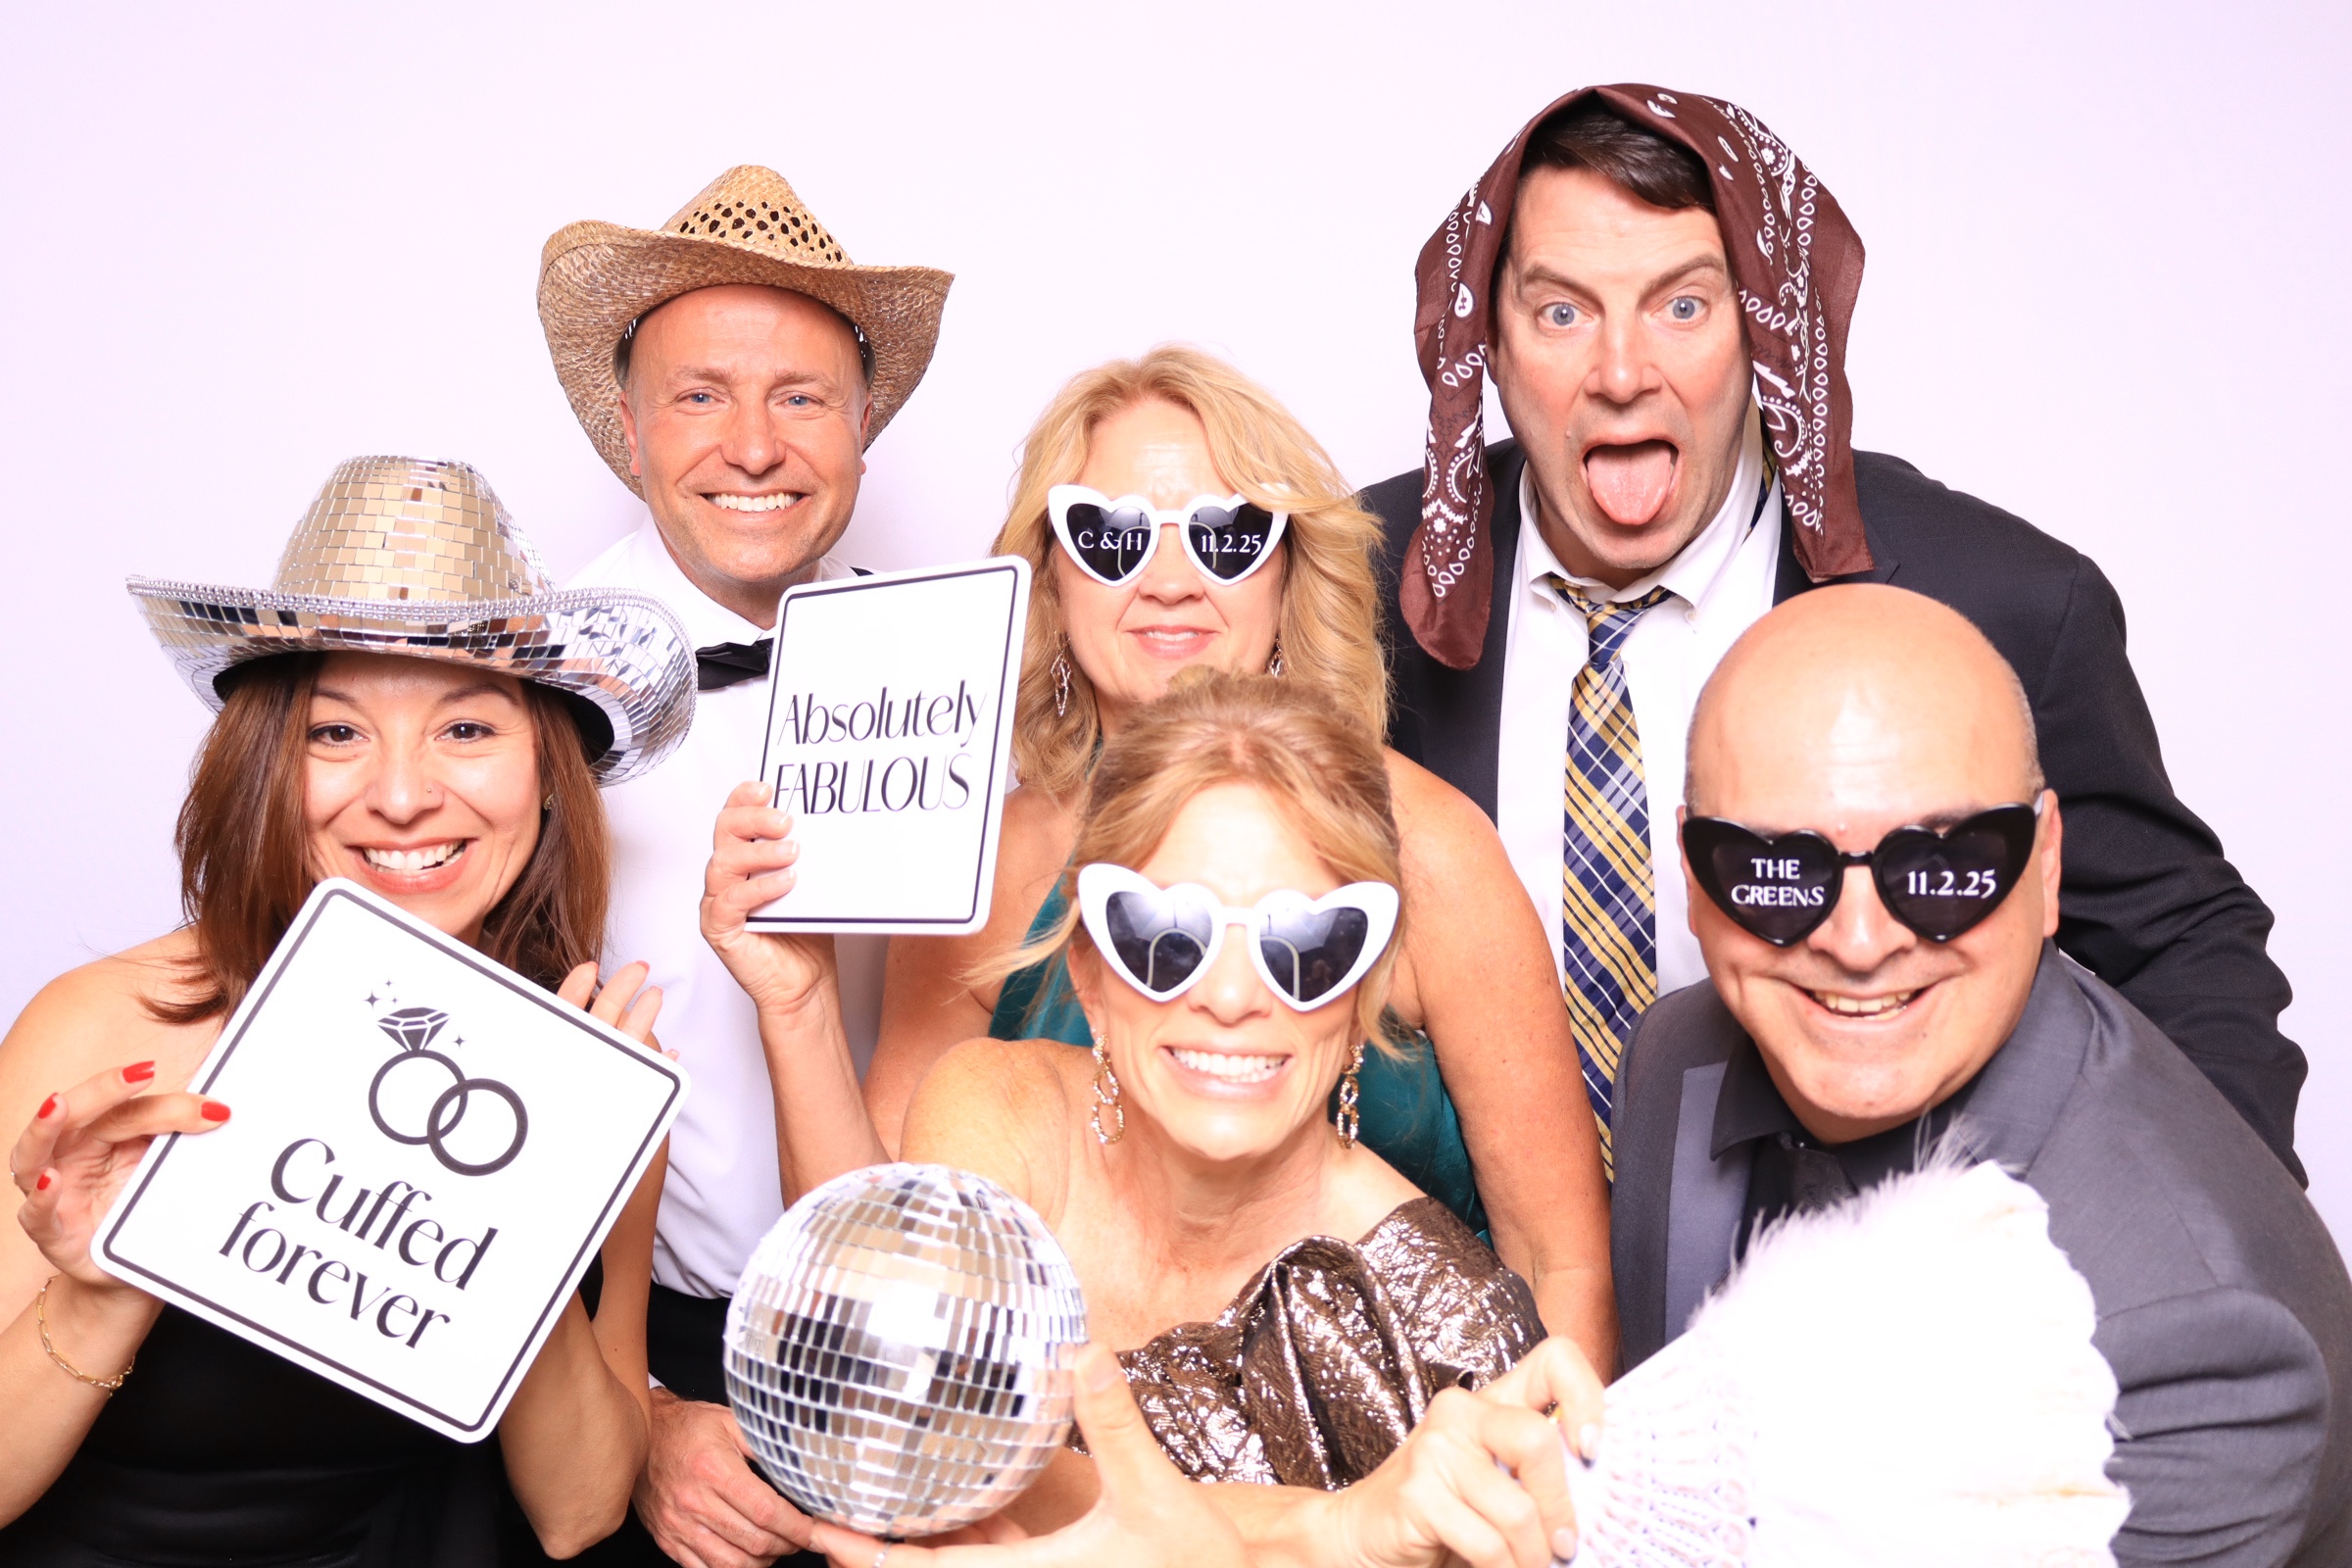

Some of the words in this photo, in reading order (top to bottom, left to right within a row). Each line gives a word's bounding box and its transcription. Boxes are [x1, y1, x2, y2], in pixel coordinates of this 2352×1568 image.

[1078, 531, 1094, 550] C
[1100, 531, 1120, 550] &
[1127, 532, 1142, 551] H
[1201, 534, 1262, 555] 11.2.25
[777, 679, 987, 748] Absolutely
[773, 753, 972, 814] FABULOUS
[1750, 858, 1800, 879] THE
[1731, 884, 1825, 906] GREENS
[1907, 869, 1996, 900] 11.2.25
[270, 1138, 499, 1291] Cuffed
[219, 1201, 450, 1349] forever
